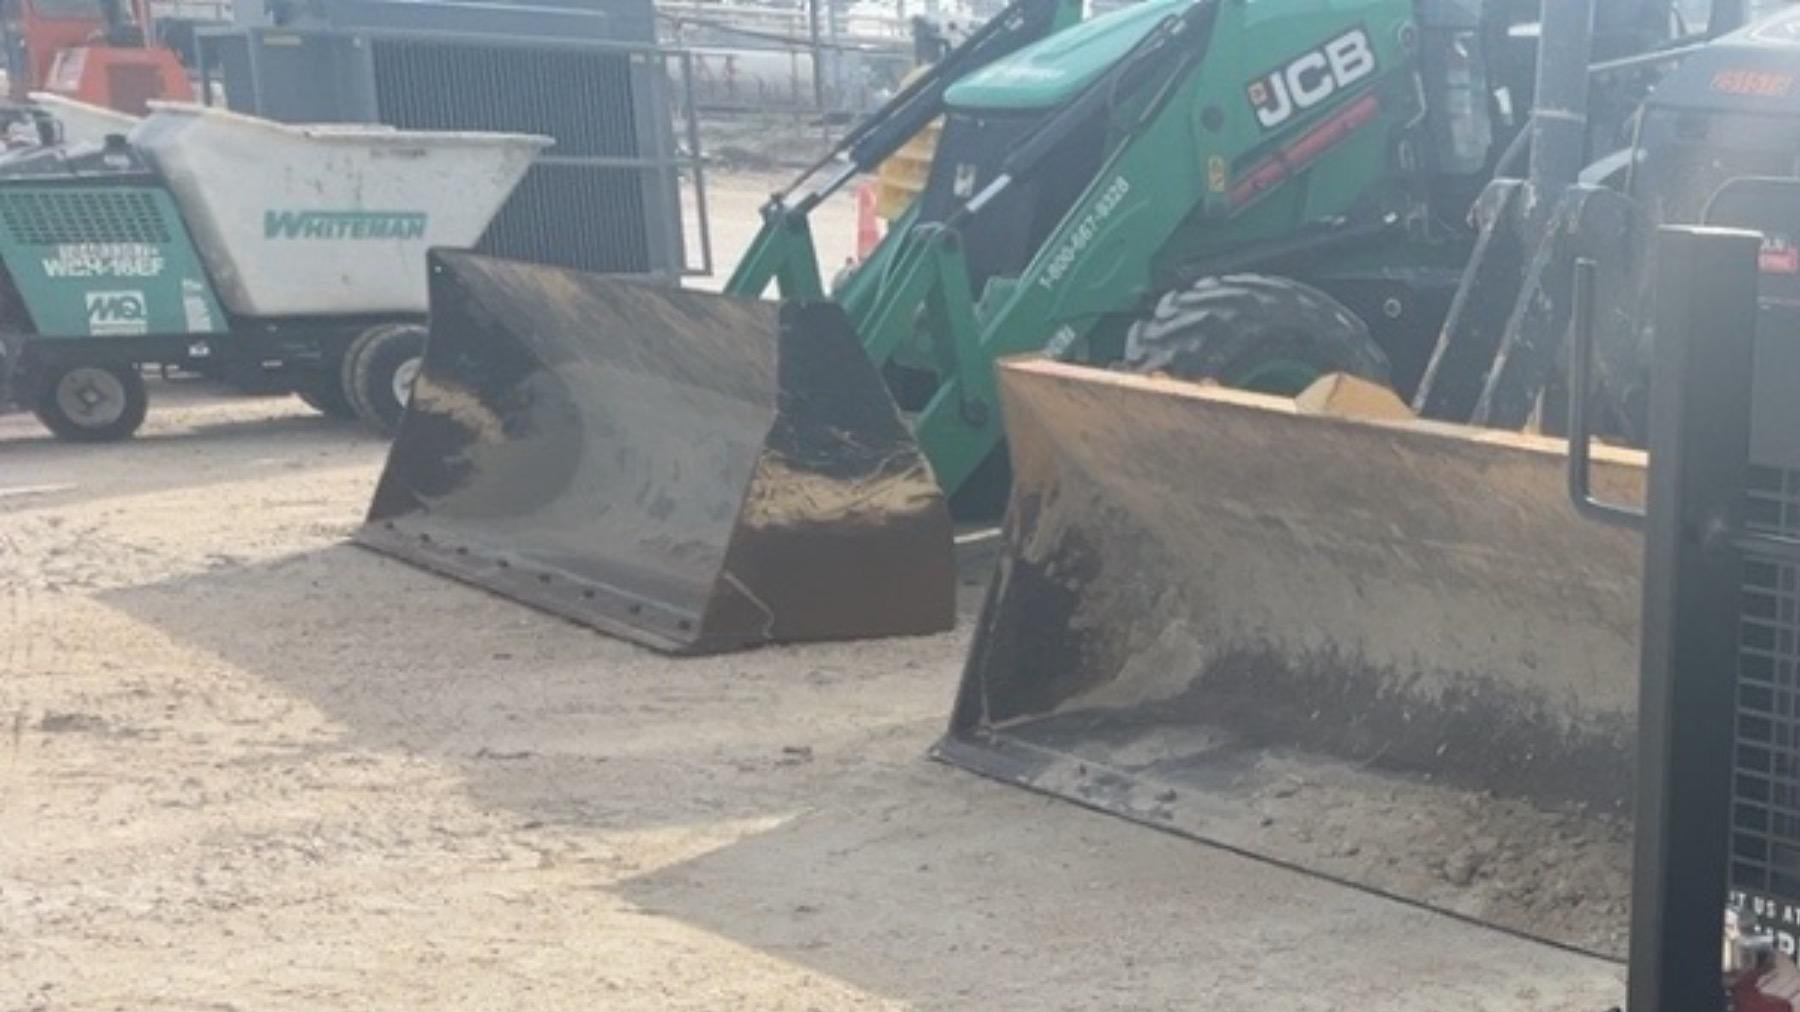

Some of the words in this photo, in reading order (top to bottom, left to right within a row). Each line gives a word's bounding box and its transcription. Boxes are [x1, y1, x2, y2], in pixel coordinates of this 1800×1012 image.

[1257, 29, 1375, 127] JCB
[264, 210, 428, 240] WHITEMAN
[1753, 896, 1777, 919] US
